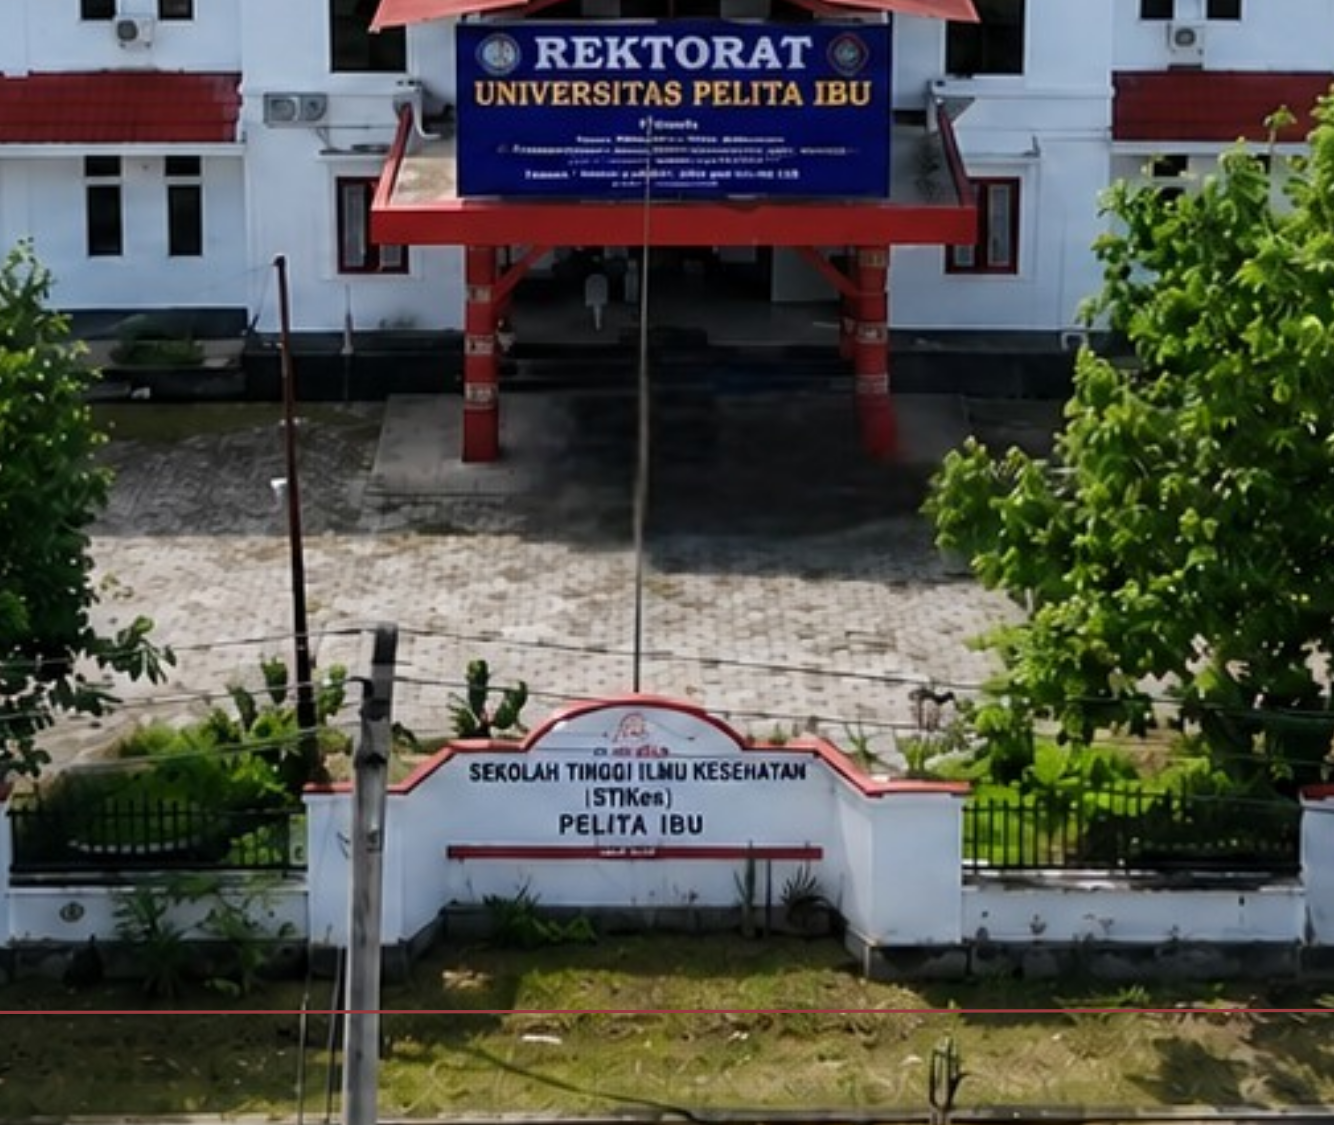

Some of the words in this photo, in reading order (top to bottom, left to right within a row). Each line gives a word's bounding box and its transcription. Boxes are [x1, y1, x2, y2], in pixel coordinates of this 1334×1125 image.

[534, 35, 813, 70] REKTORAT
[474, 80, 682, 106] UNIVERSITAS
[693, 80, 804, 106] PELITA
[813, 80, 872, 106] IBU
[469, 762, 560, 783] SEKOLAH
[638, 762, 688, 781] ILMU
[693, 761, 806, 781] KESEHATAN
[585, 786, 672, 809] (STIKes)
[559, 813, 648, 836] PELITA
[661, 813, 704, 836] IBU
